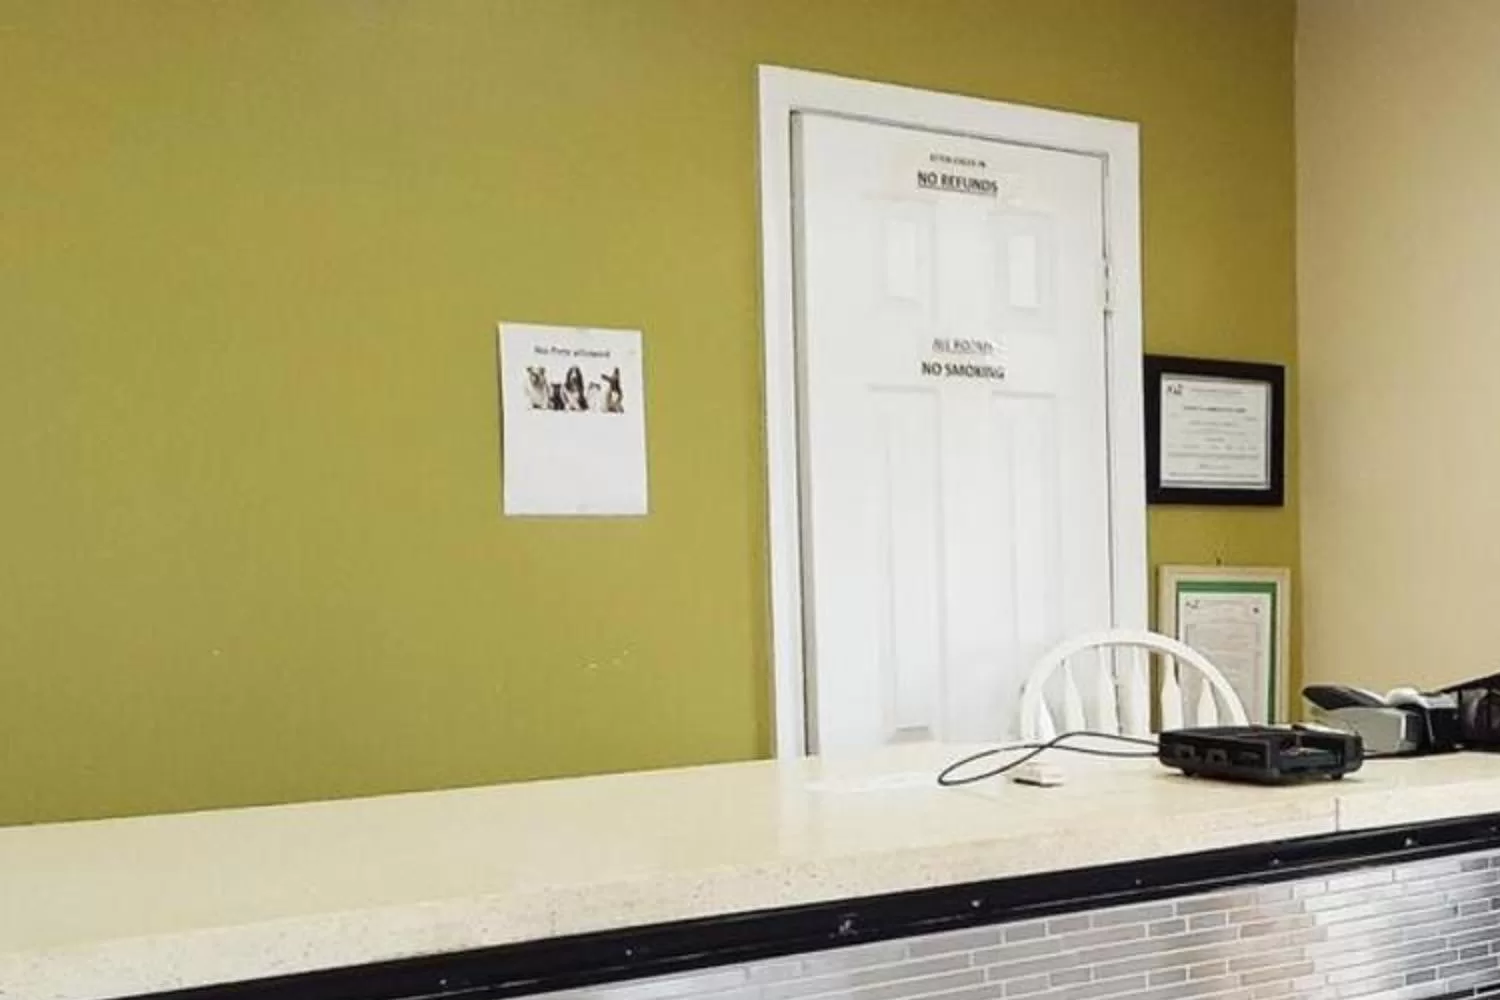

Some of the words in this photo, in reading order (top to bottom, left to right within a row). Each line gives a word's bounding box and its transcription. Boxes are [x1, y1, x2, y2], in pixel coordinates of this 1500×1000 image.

[918, 170, 939, 185] NO
[941, 174, 999, 192] REFUNDS
[921, 361, 942, 377] NO
[944, 363, 1005, 380] SMOKING
